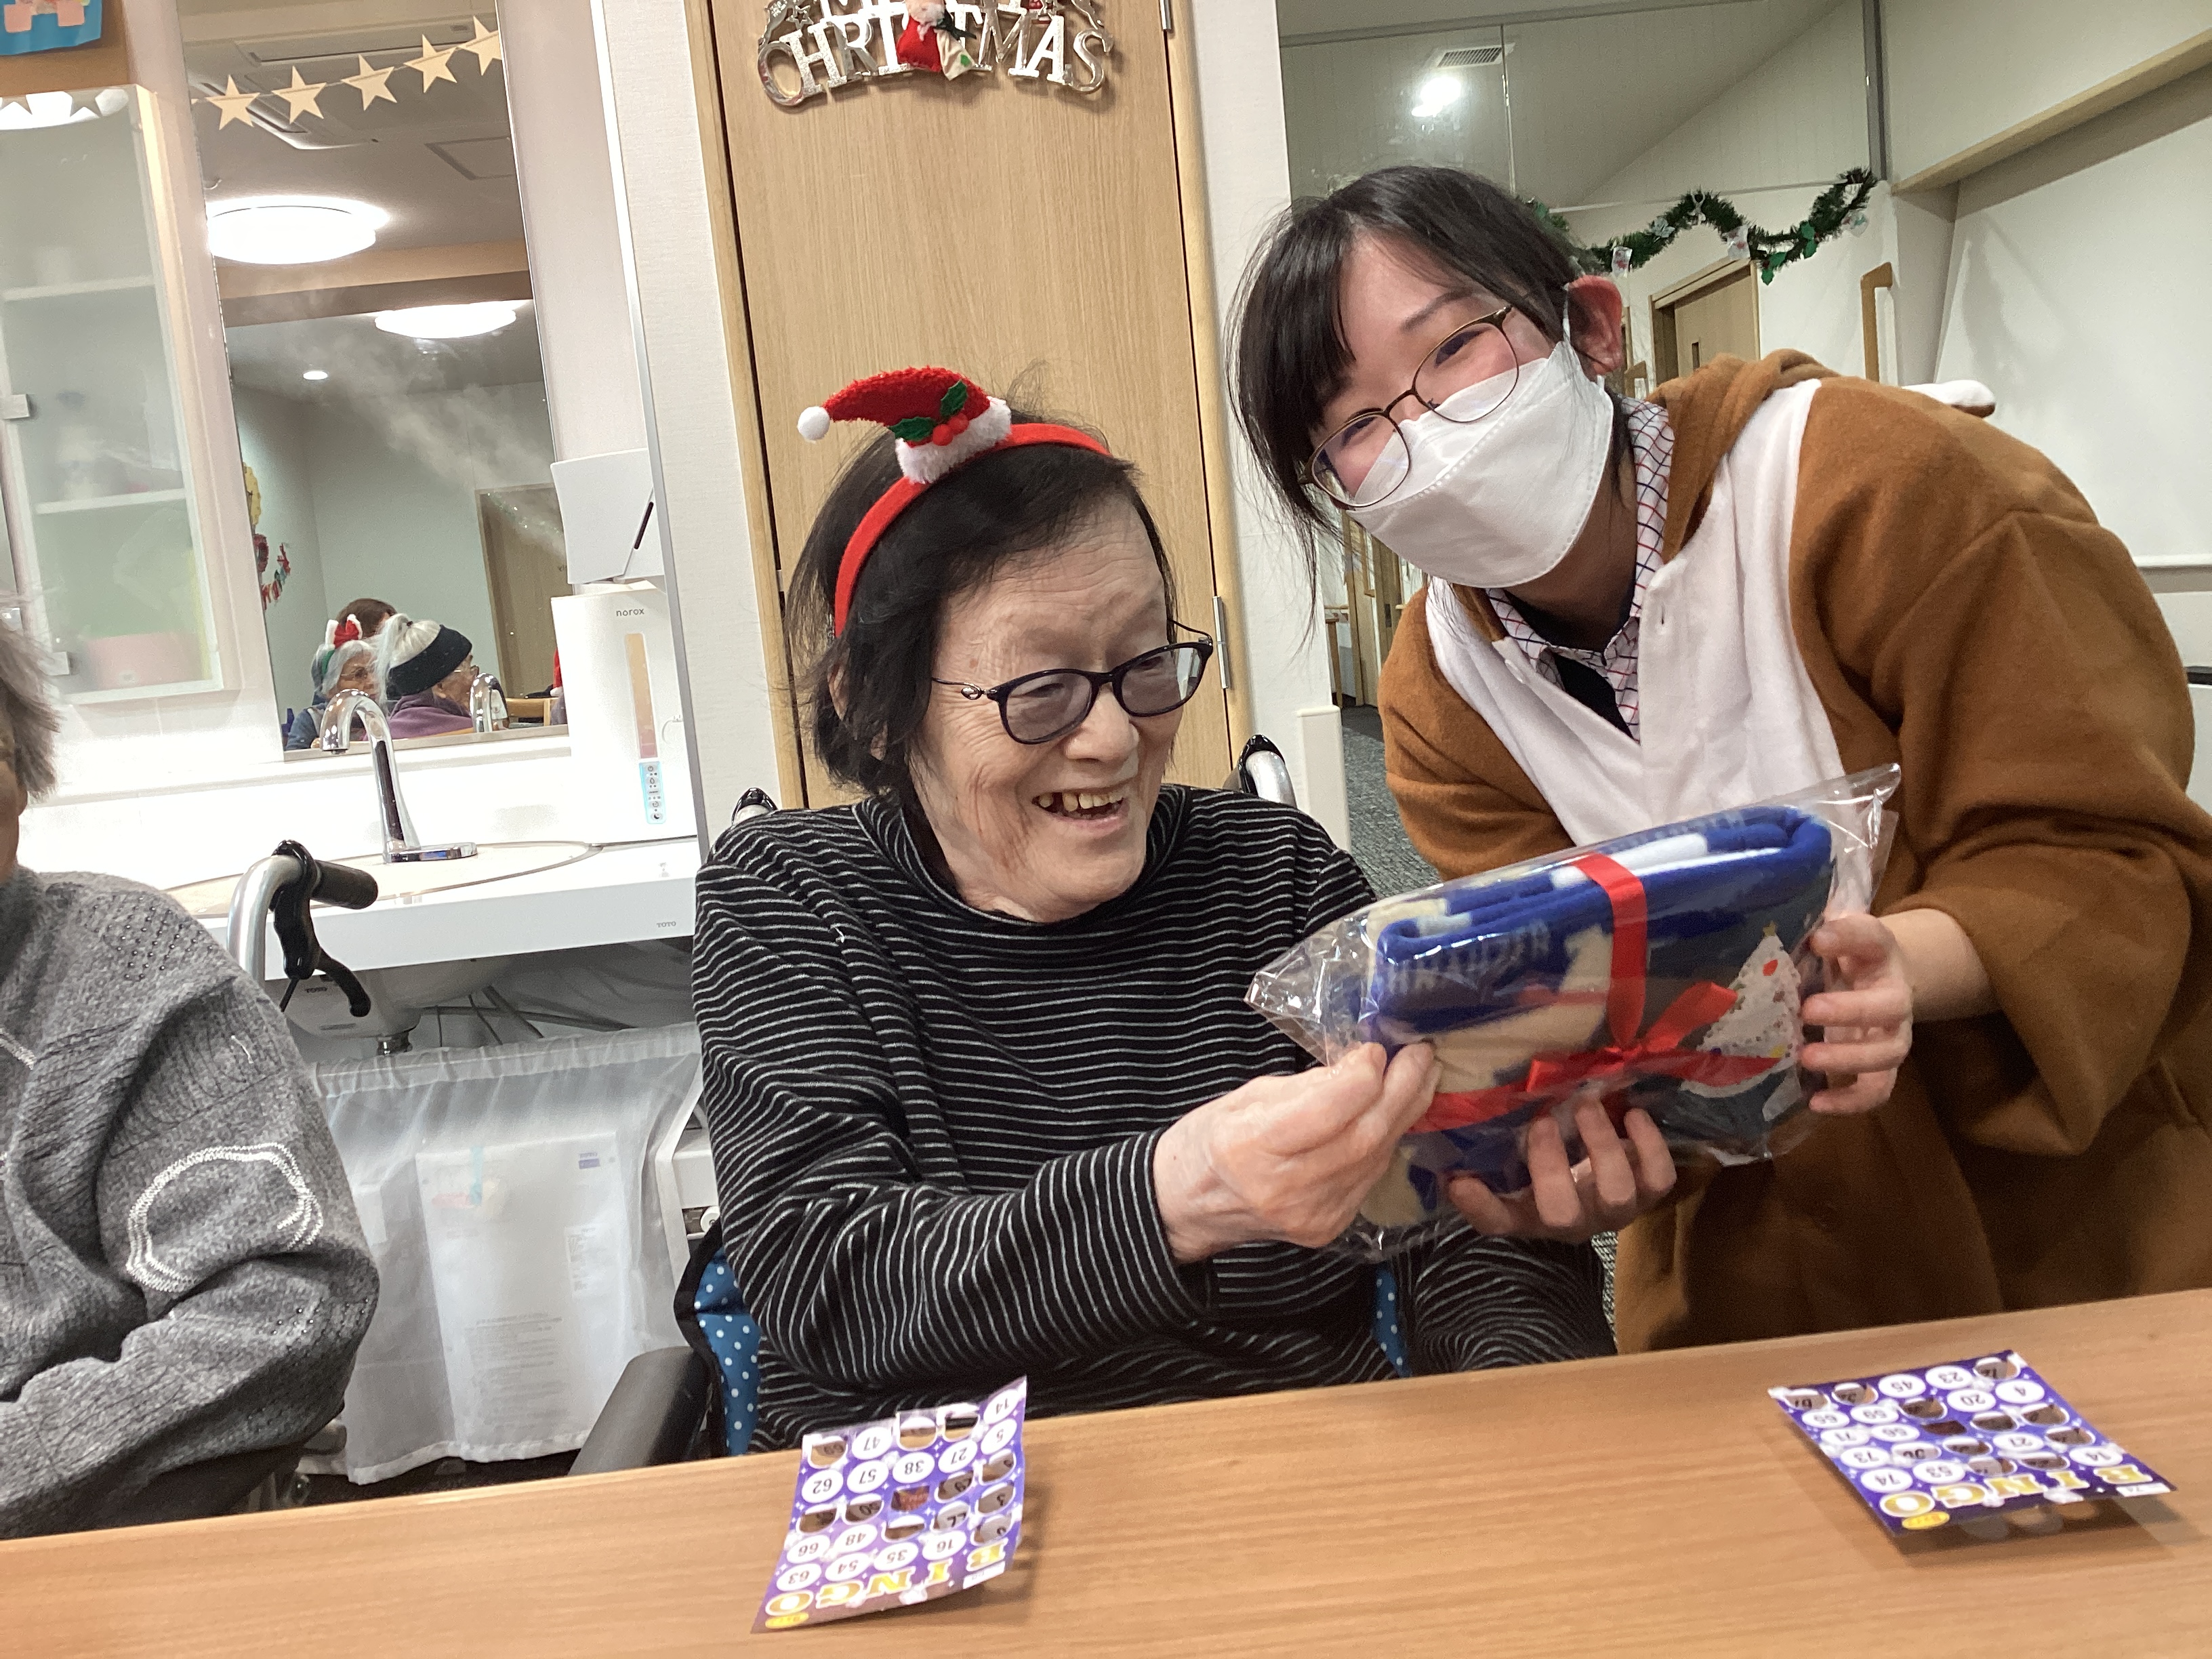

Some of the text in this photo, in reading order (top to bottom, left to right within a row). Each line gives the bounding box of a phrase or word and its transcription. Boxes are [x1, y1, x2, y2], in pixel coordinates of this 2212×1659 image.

[616, 609, 644, 617] norox
[1891, 1380, 1912, 1392] 45
[1939, 1372, 1963, 1384] 23
[1961, 1387, 2026, 1406] 4 20
[996, 1398, 1009, 1415] 14
[863, 1436, 880, 1452] 47
[813, 1429, 1004, 1494] 5 27 38 57 62
[1853, 1452, 1879, 1463] 73
[1875, 1452, 2110, 1486] 14 53 74
[1880, 1465, 2153, 1517] BINGO
[798, 1532, 866, 1557] 48 66
[788, 1538, 954, 1584] 16 35 54 63
[765, 1537, 1008, 1616] BINGO
